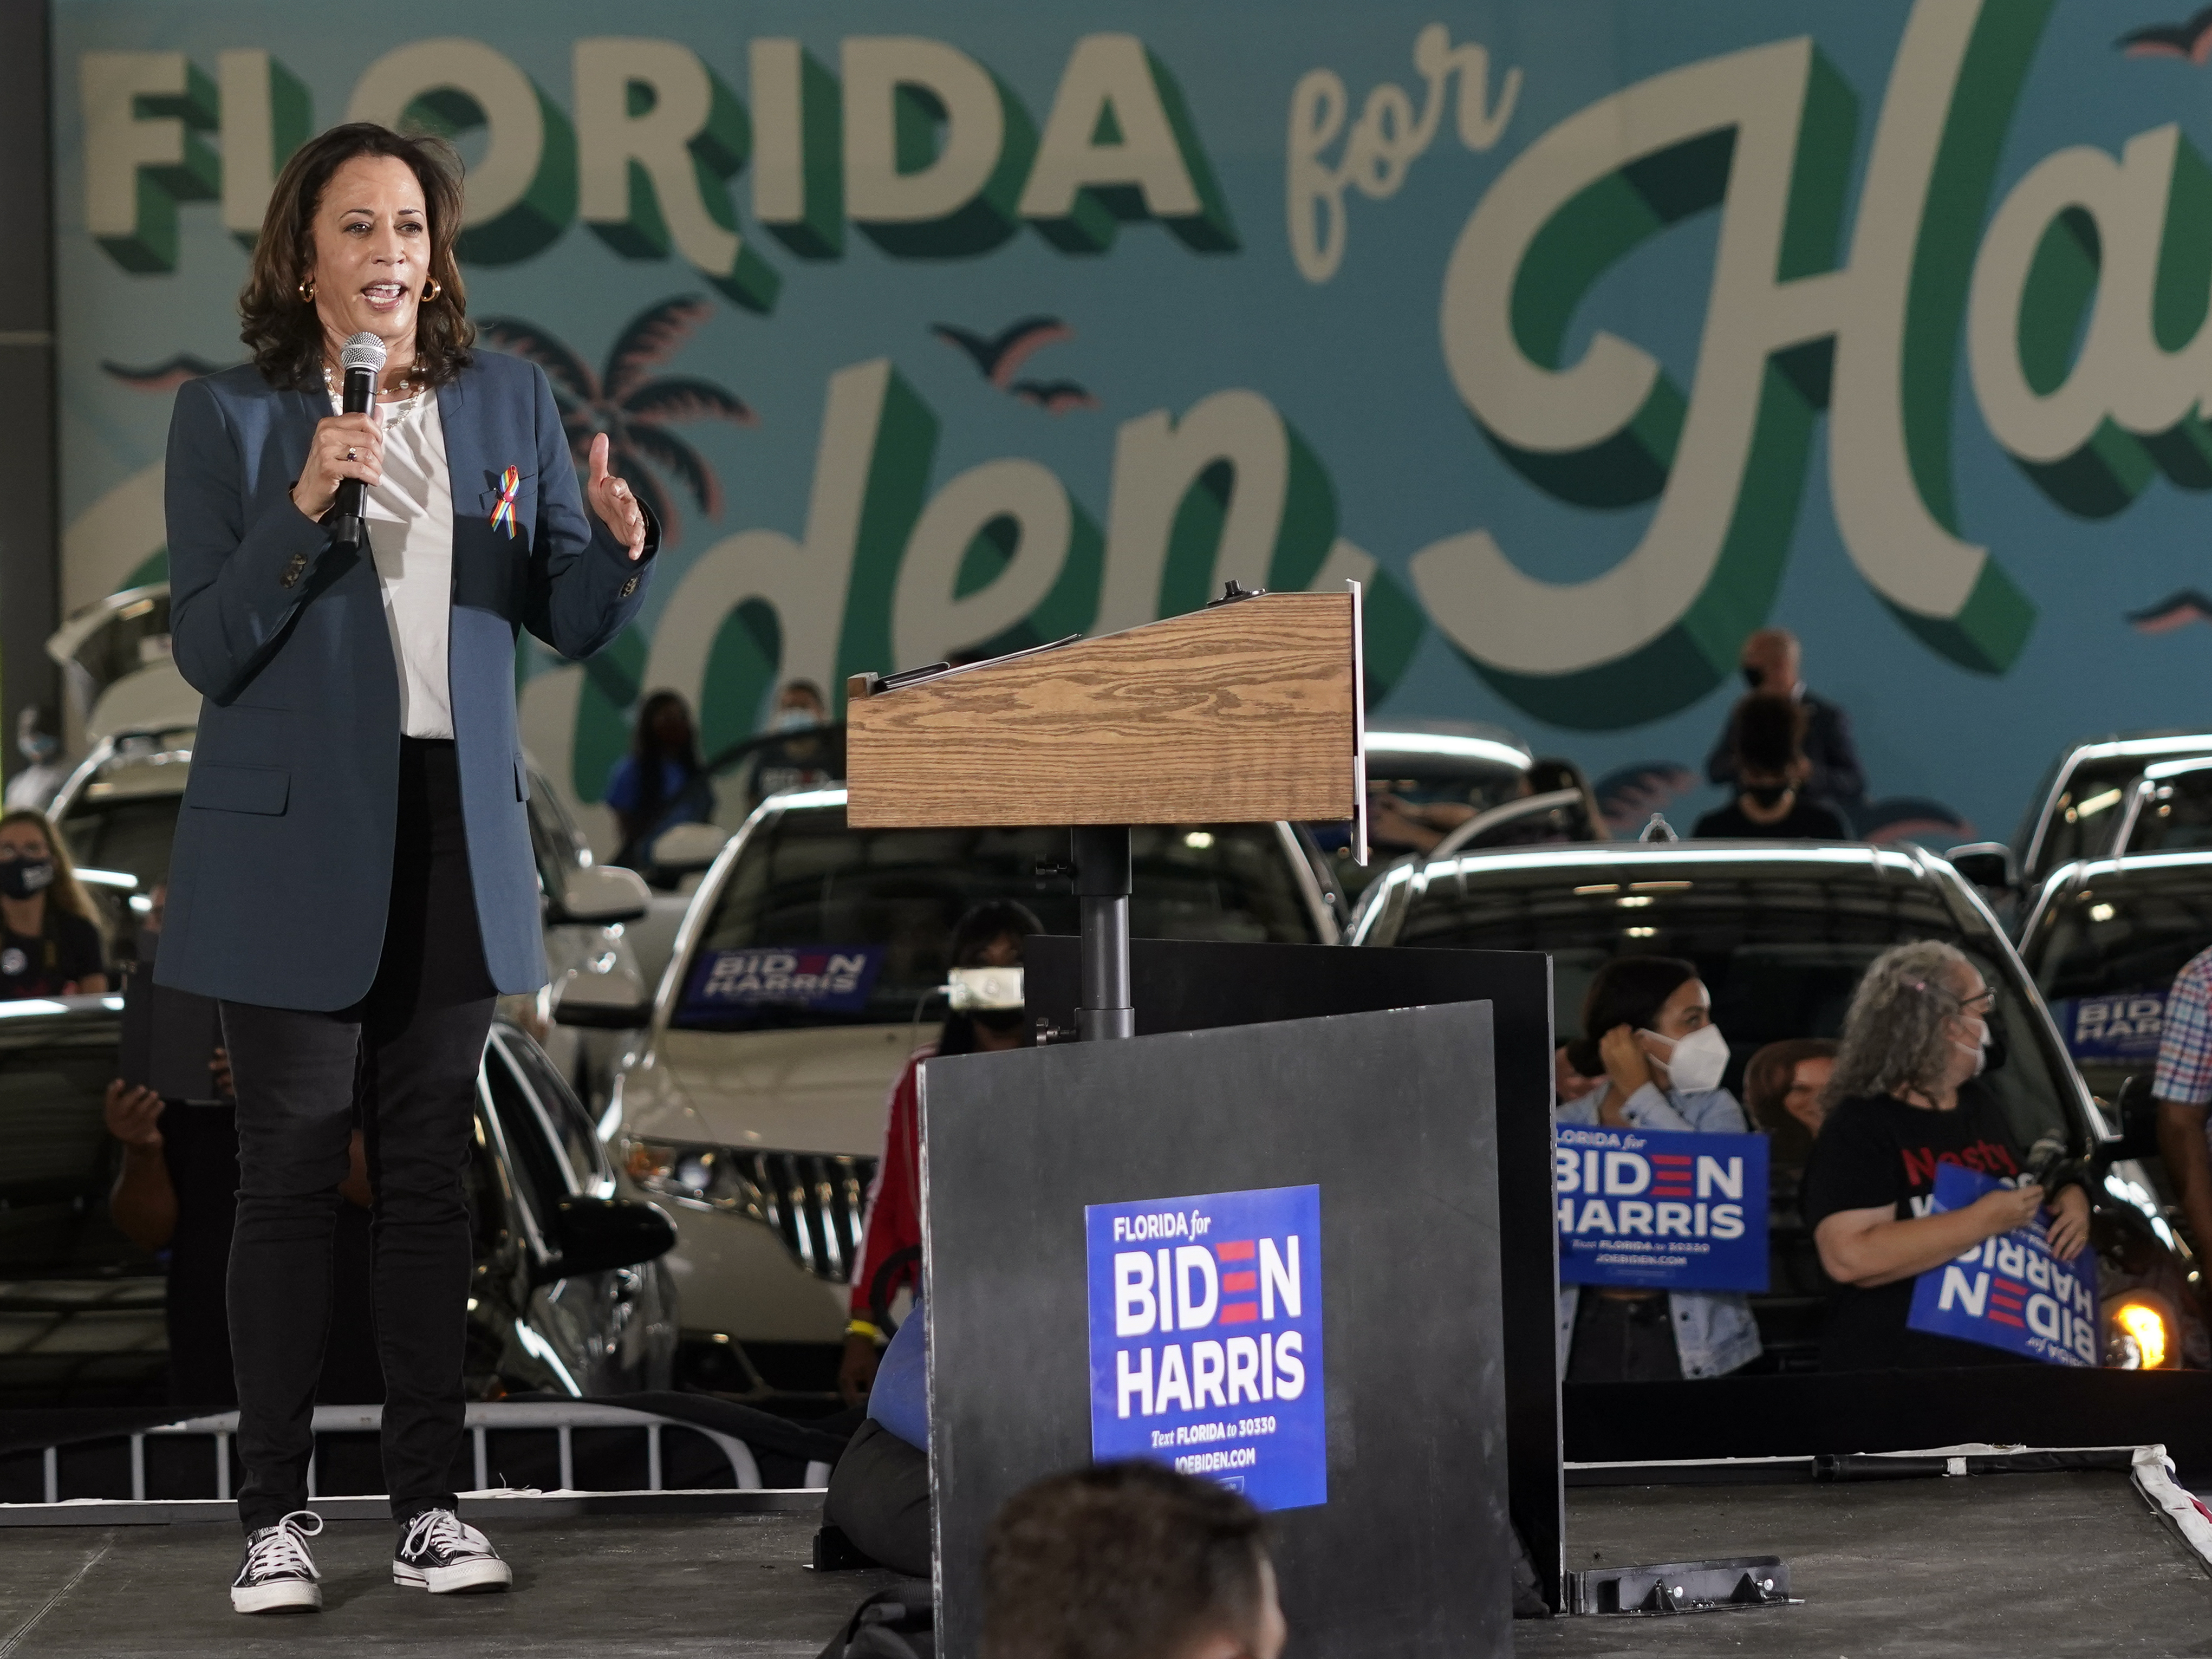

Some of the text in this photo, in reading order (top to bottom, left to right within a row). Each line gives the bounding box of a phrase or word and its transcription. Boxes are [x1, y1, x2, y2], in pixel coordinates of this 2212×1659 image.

[79, 22, 1523, 284] FLORIDA for
[2077, 999, 2164, 1024] BID
[1557, 1147, 1743, 1200] BIDEN
[1114, 1209, 1212, 1242] FLORIDA for
[1557, 1198, 1746, 1239] HARRIS
[1114, 1234, 1302, 1338] BIDEN
[1937, 1265, 2098, 1367] BIDEN
[1116, 1330, 1305, 1419] HARRIS
[1151, 1415, 1277, 1448] Text FLORIDA to 30330
